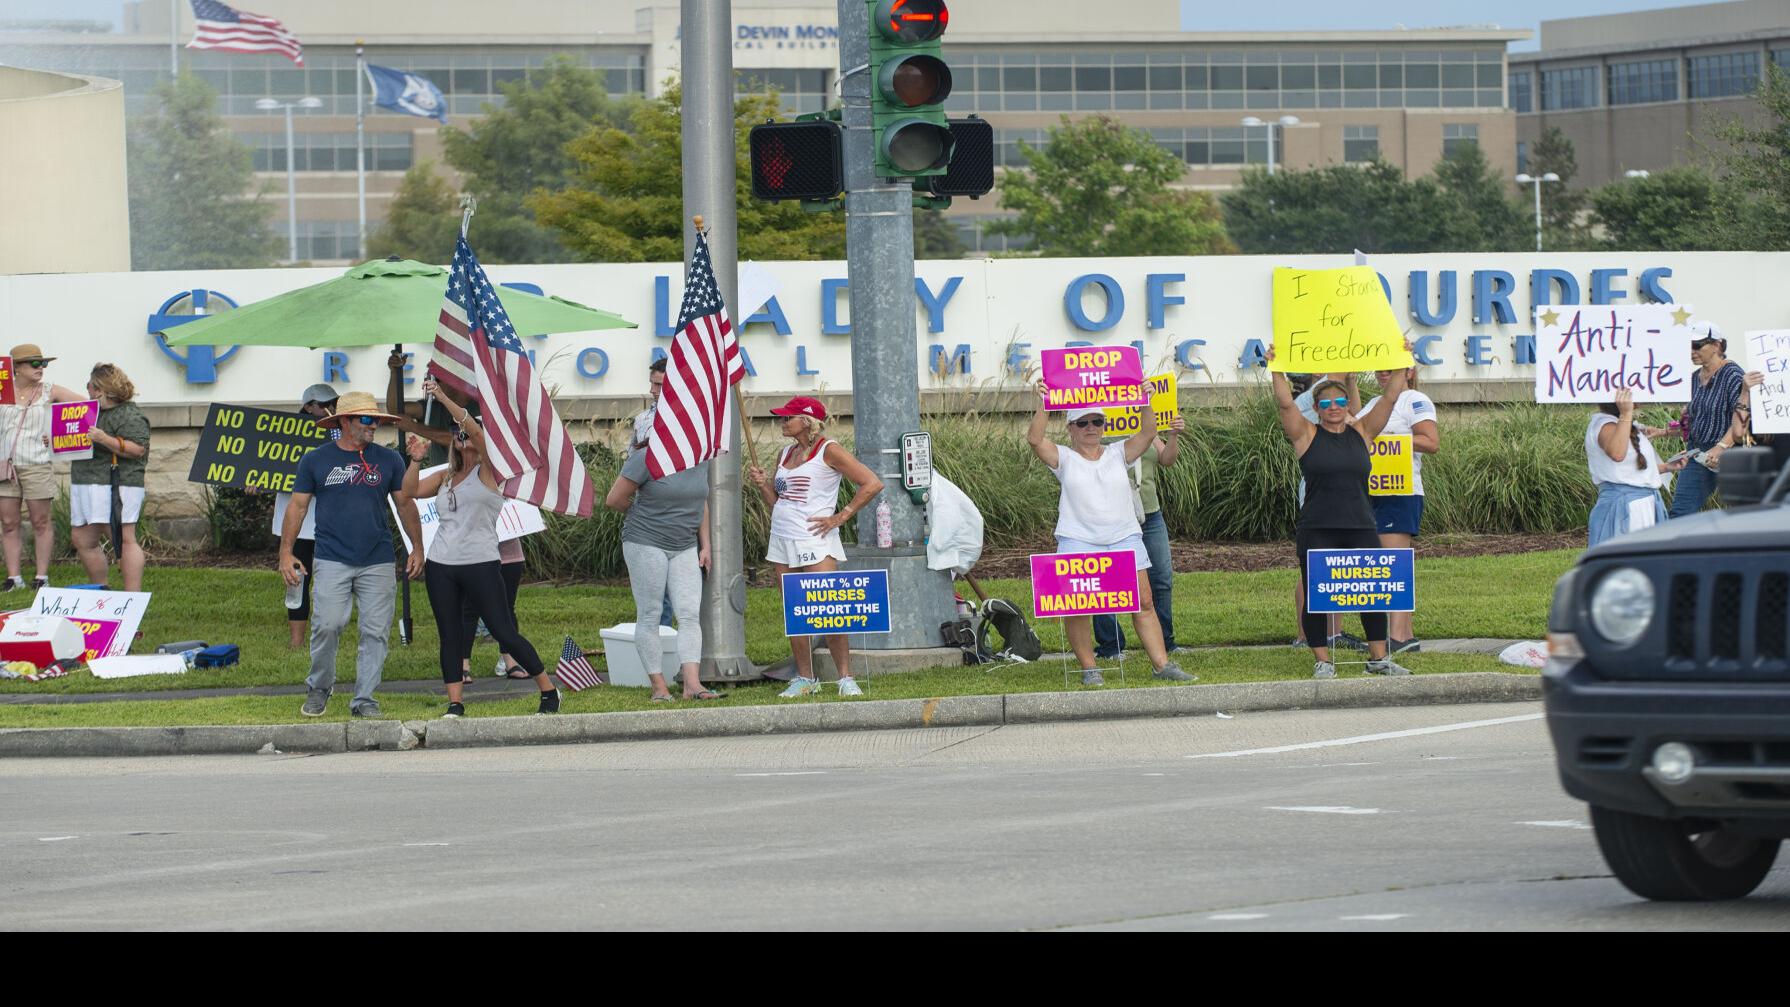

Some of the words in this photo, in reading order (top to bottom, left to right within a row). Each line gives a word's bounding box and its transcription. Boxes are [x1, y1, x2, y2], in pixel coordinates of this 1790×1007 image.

[736, 24, 789, 40] DEVIN
[796, 24, 839, 40] MON
[1292, 274, 1309, 299] I
[1064, 273, 1186, 331] OF
[1319, 304, 1353, 327] for
[1289, 328, 1390, 363] Freedom
[1064, 350, 1122, 370] DROP
[1766, 357, 1788, 373] Ex
[1079, 371, 1110, 386] THE
[1548, 348, 1683, 398] Mandate
[1049, 384, 1143, 406] MANDATES!
[1760, 379, 1786, 397] And
[61, 405, 89, 421] DROP
[65, 421, 80, 434] THE
[215, 408, 245, 429] NO
[255, 413, 327, 440] CHOICE
[53, 433, 92, 449] MANDATES
[216, 434, 246, 455] NO
[206, 462, 236, 483] NO
[245, 468, 297, 492] CARE
[1055, 556, 1112, 577] DROP
[1325, 556, 1361, 567] WHAT
[1364, 555, 1376, 566] %
[1378, 555, 1396, 565] OF
[1331, 566, 1391, 579] NURSES
[799, 578, 836, 590] WHAT
[839, 577, 850, 588] %
[853, 576, 870, 588] OF
[1070, 577, 1101, 592] THE
[1317, 581, 1376, 593] SUPPORT
[1378, 581, 1406, 592] THE
[806, 588, 866, 602] NURSES
[1039, 590, 1135, 612] MANDATES!
[41, 596, 80, 615] What
[114, 598, 133, 616] of
[793, 604, 851, 617] SUPPORT
[854, 603, 880, 614] THE
